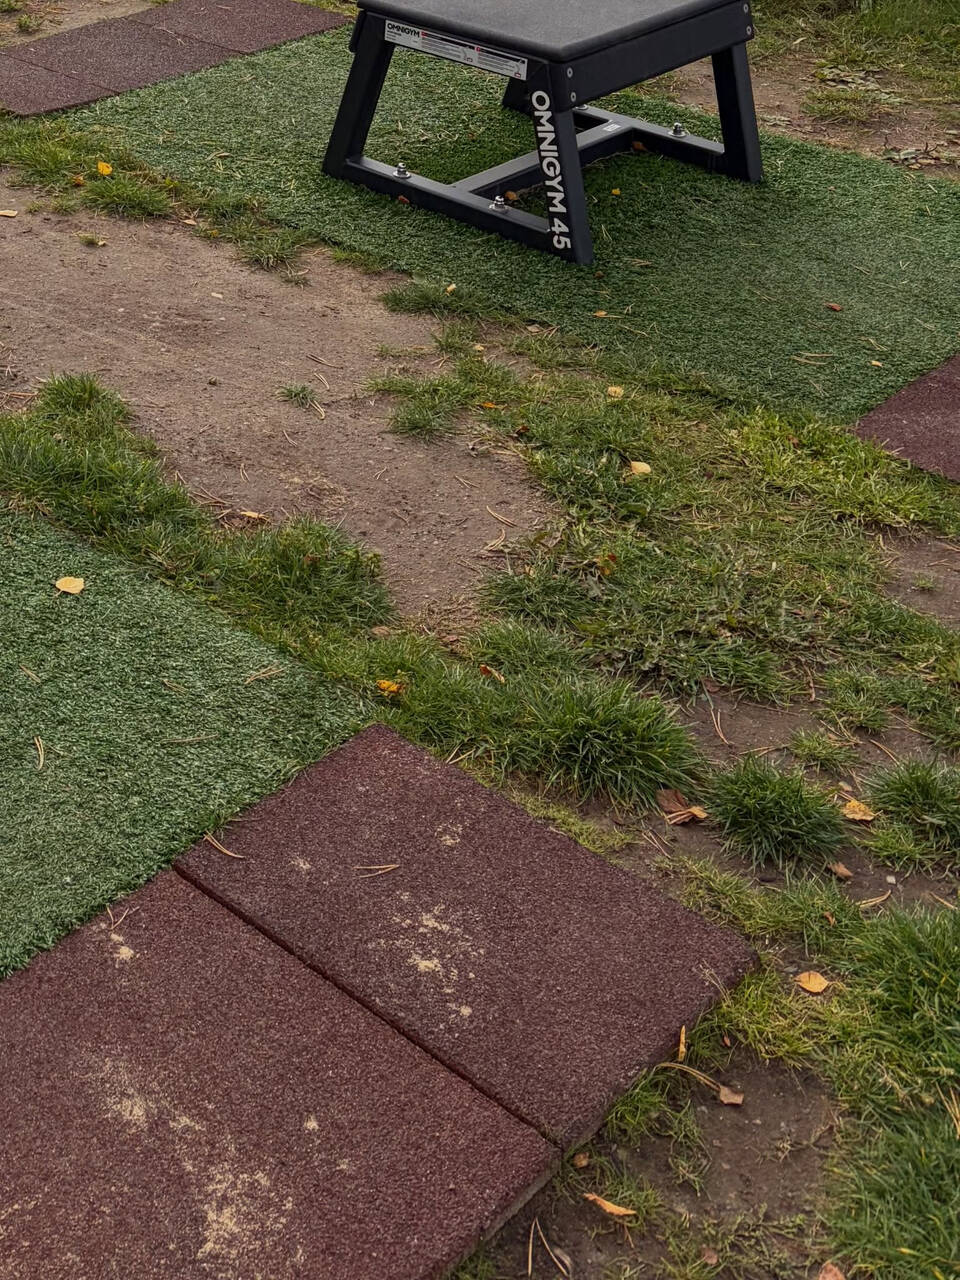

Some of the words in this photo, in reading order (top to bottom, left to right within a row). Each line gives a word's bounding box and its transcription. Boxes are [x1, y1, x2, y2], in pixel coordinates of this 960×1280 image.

[387, 23, 420, 38] OMNIGYM
[531, 90, 567, 214] OMNIGYM
[550, 217, 572, 250] 45
